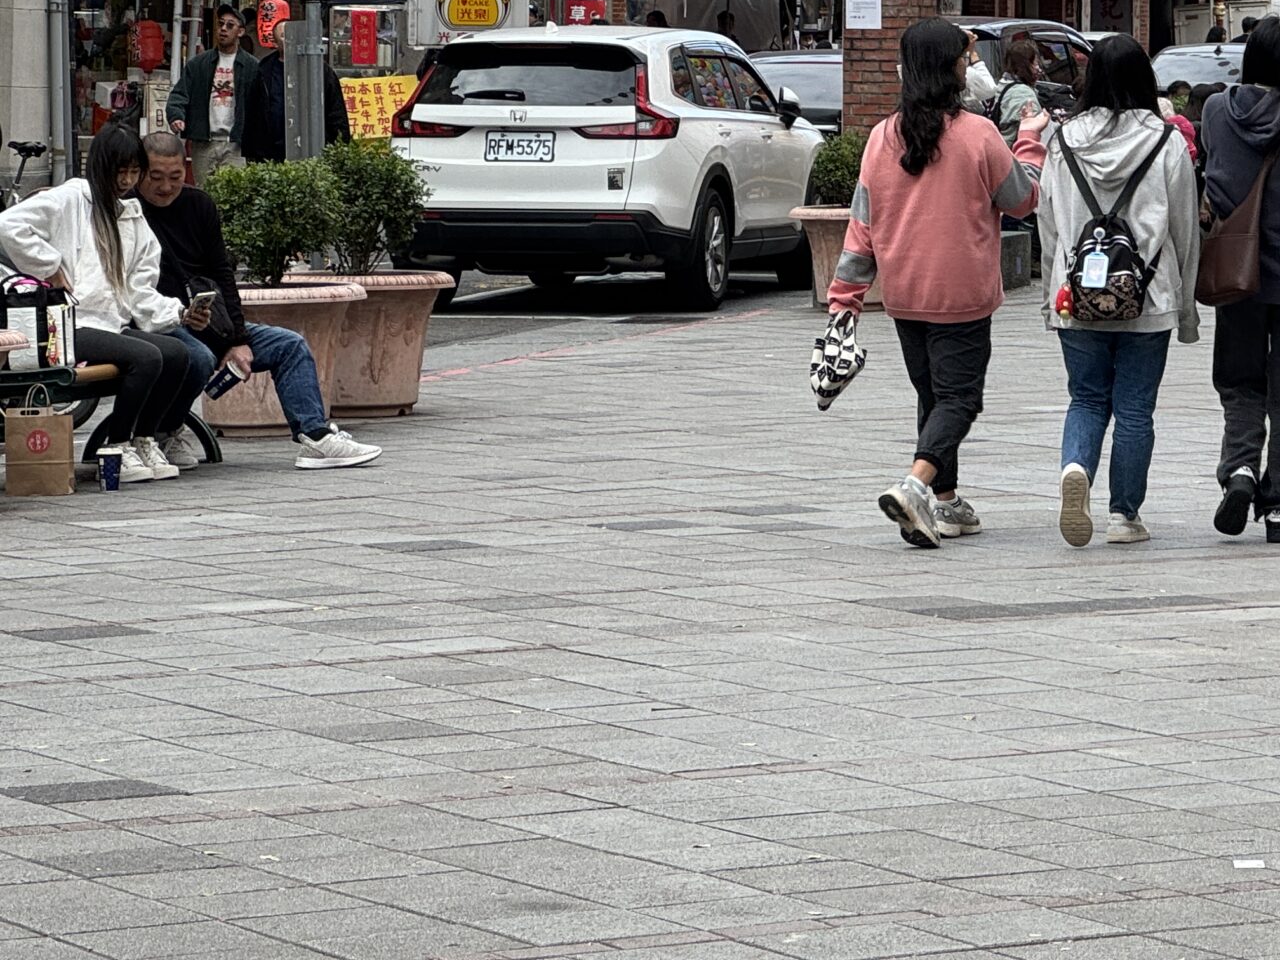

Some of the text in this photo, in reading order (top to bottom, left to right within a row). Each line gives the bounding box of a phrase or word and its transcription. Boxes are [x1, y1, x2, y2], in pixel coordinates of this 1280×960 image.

[358, 82, 375, 135] 杏仁牛奶
[488, 138, 551, 156] RFM-5375
[415, 164, 441, 172] CR-V
